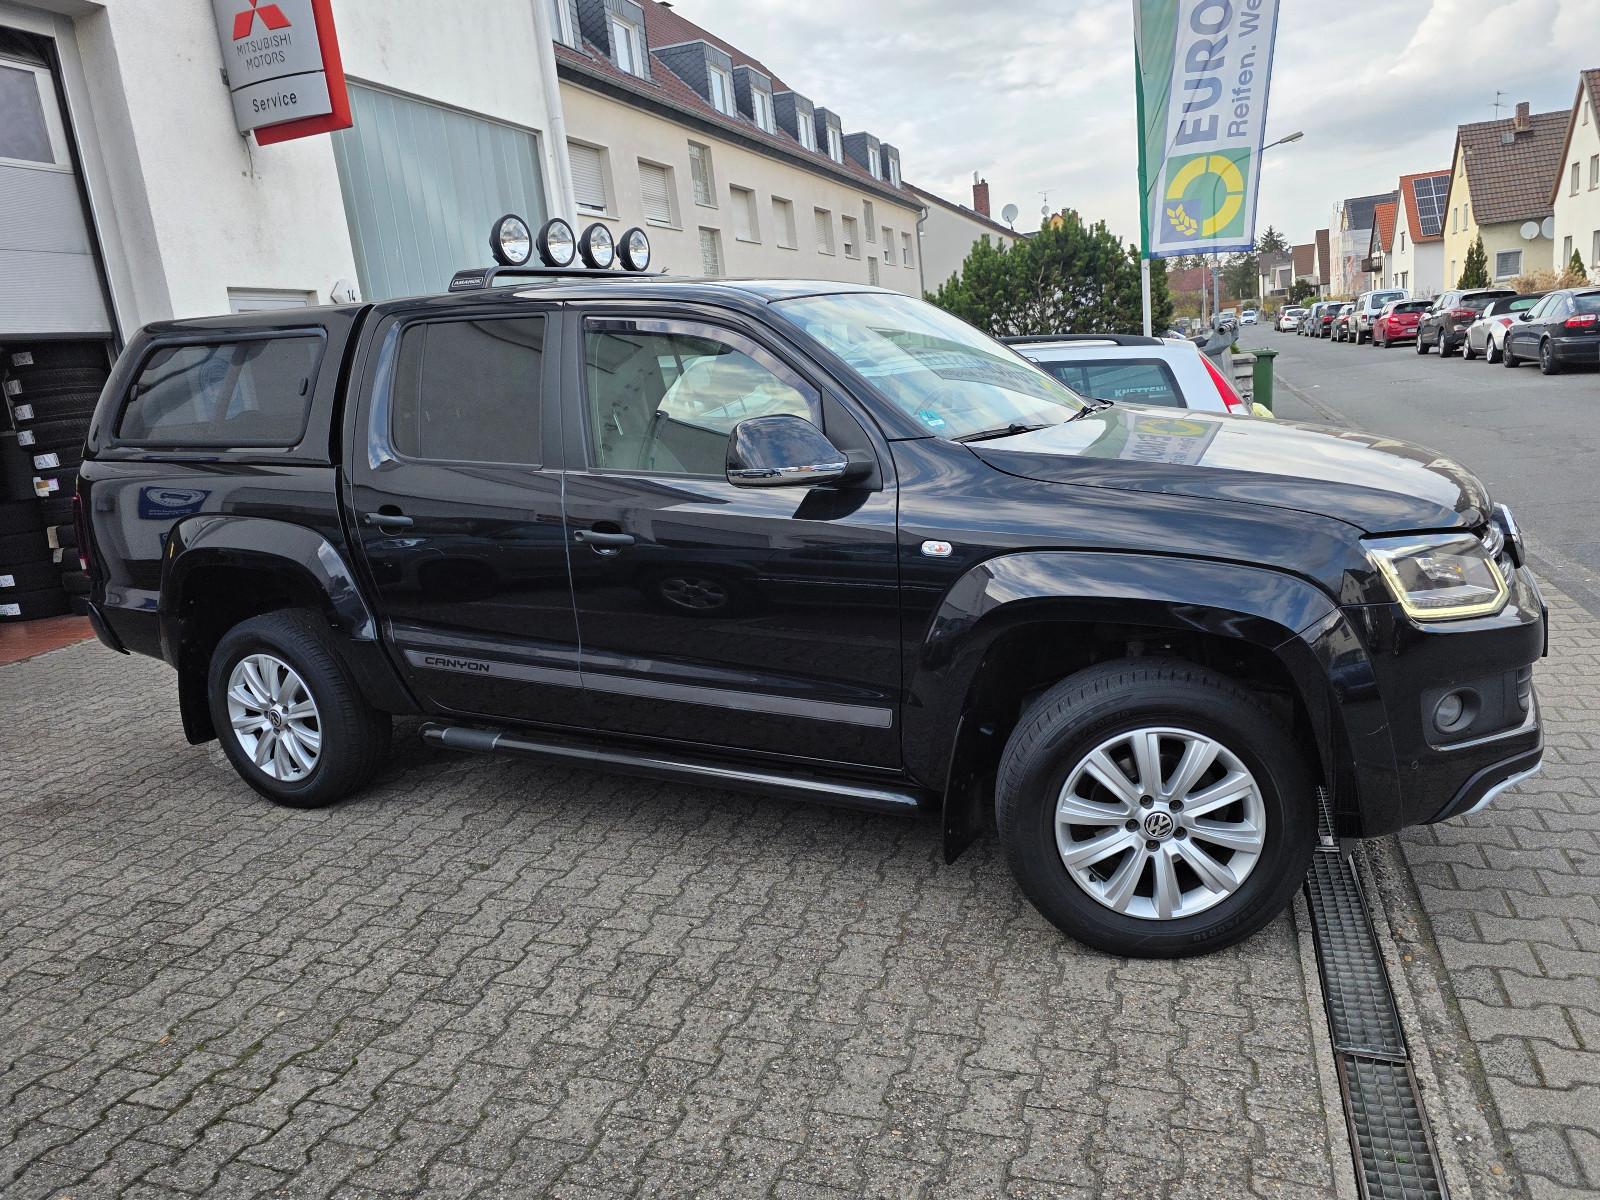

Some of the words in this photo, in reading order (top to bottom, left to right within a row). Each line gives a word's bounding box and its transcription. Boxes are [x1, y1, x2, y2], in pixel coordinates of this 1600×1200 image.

[236, 33, 292, 56] MITSUBISHI
[246, 51, 286, 70] MOTORS
[1227, 45, 1257, 138] Reifen.
[252, 92, 297, 113] Service
[425, 656, 490, 673] CANYON
